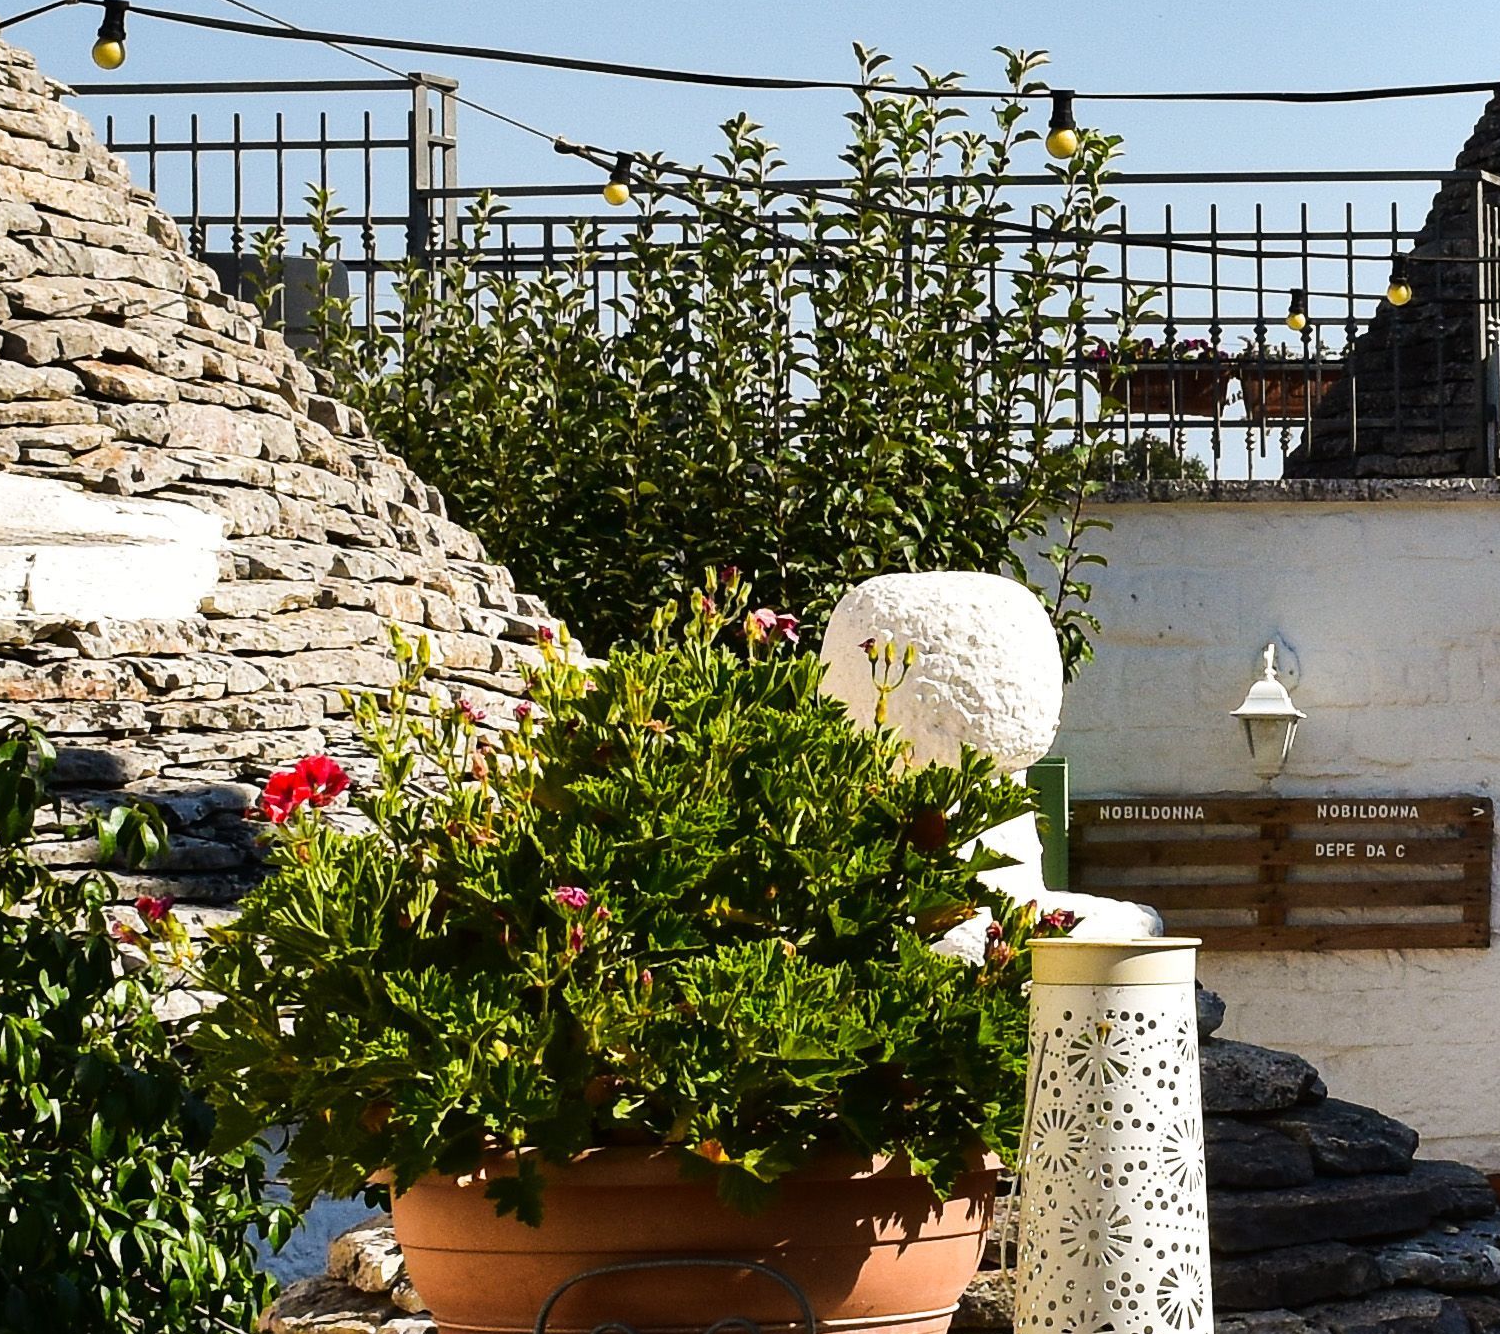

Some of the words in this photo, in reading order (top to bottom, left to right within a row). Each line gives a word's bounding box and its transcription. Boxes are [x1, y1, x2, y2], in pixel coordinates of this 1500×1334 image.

[1099, 806, 1205, 820] NOBILDONNA
[1316, 804, 1419, 818] NOBILDONNA
[1315, 843, 1356, 857] DEPE
[1366, 844, 1386, 857] DA
[1395, 844, 1405, 858] C
